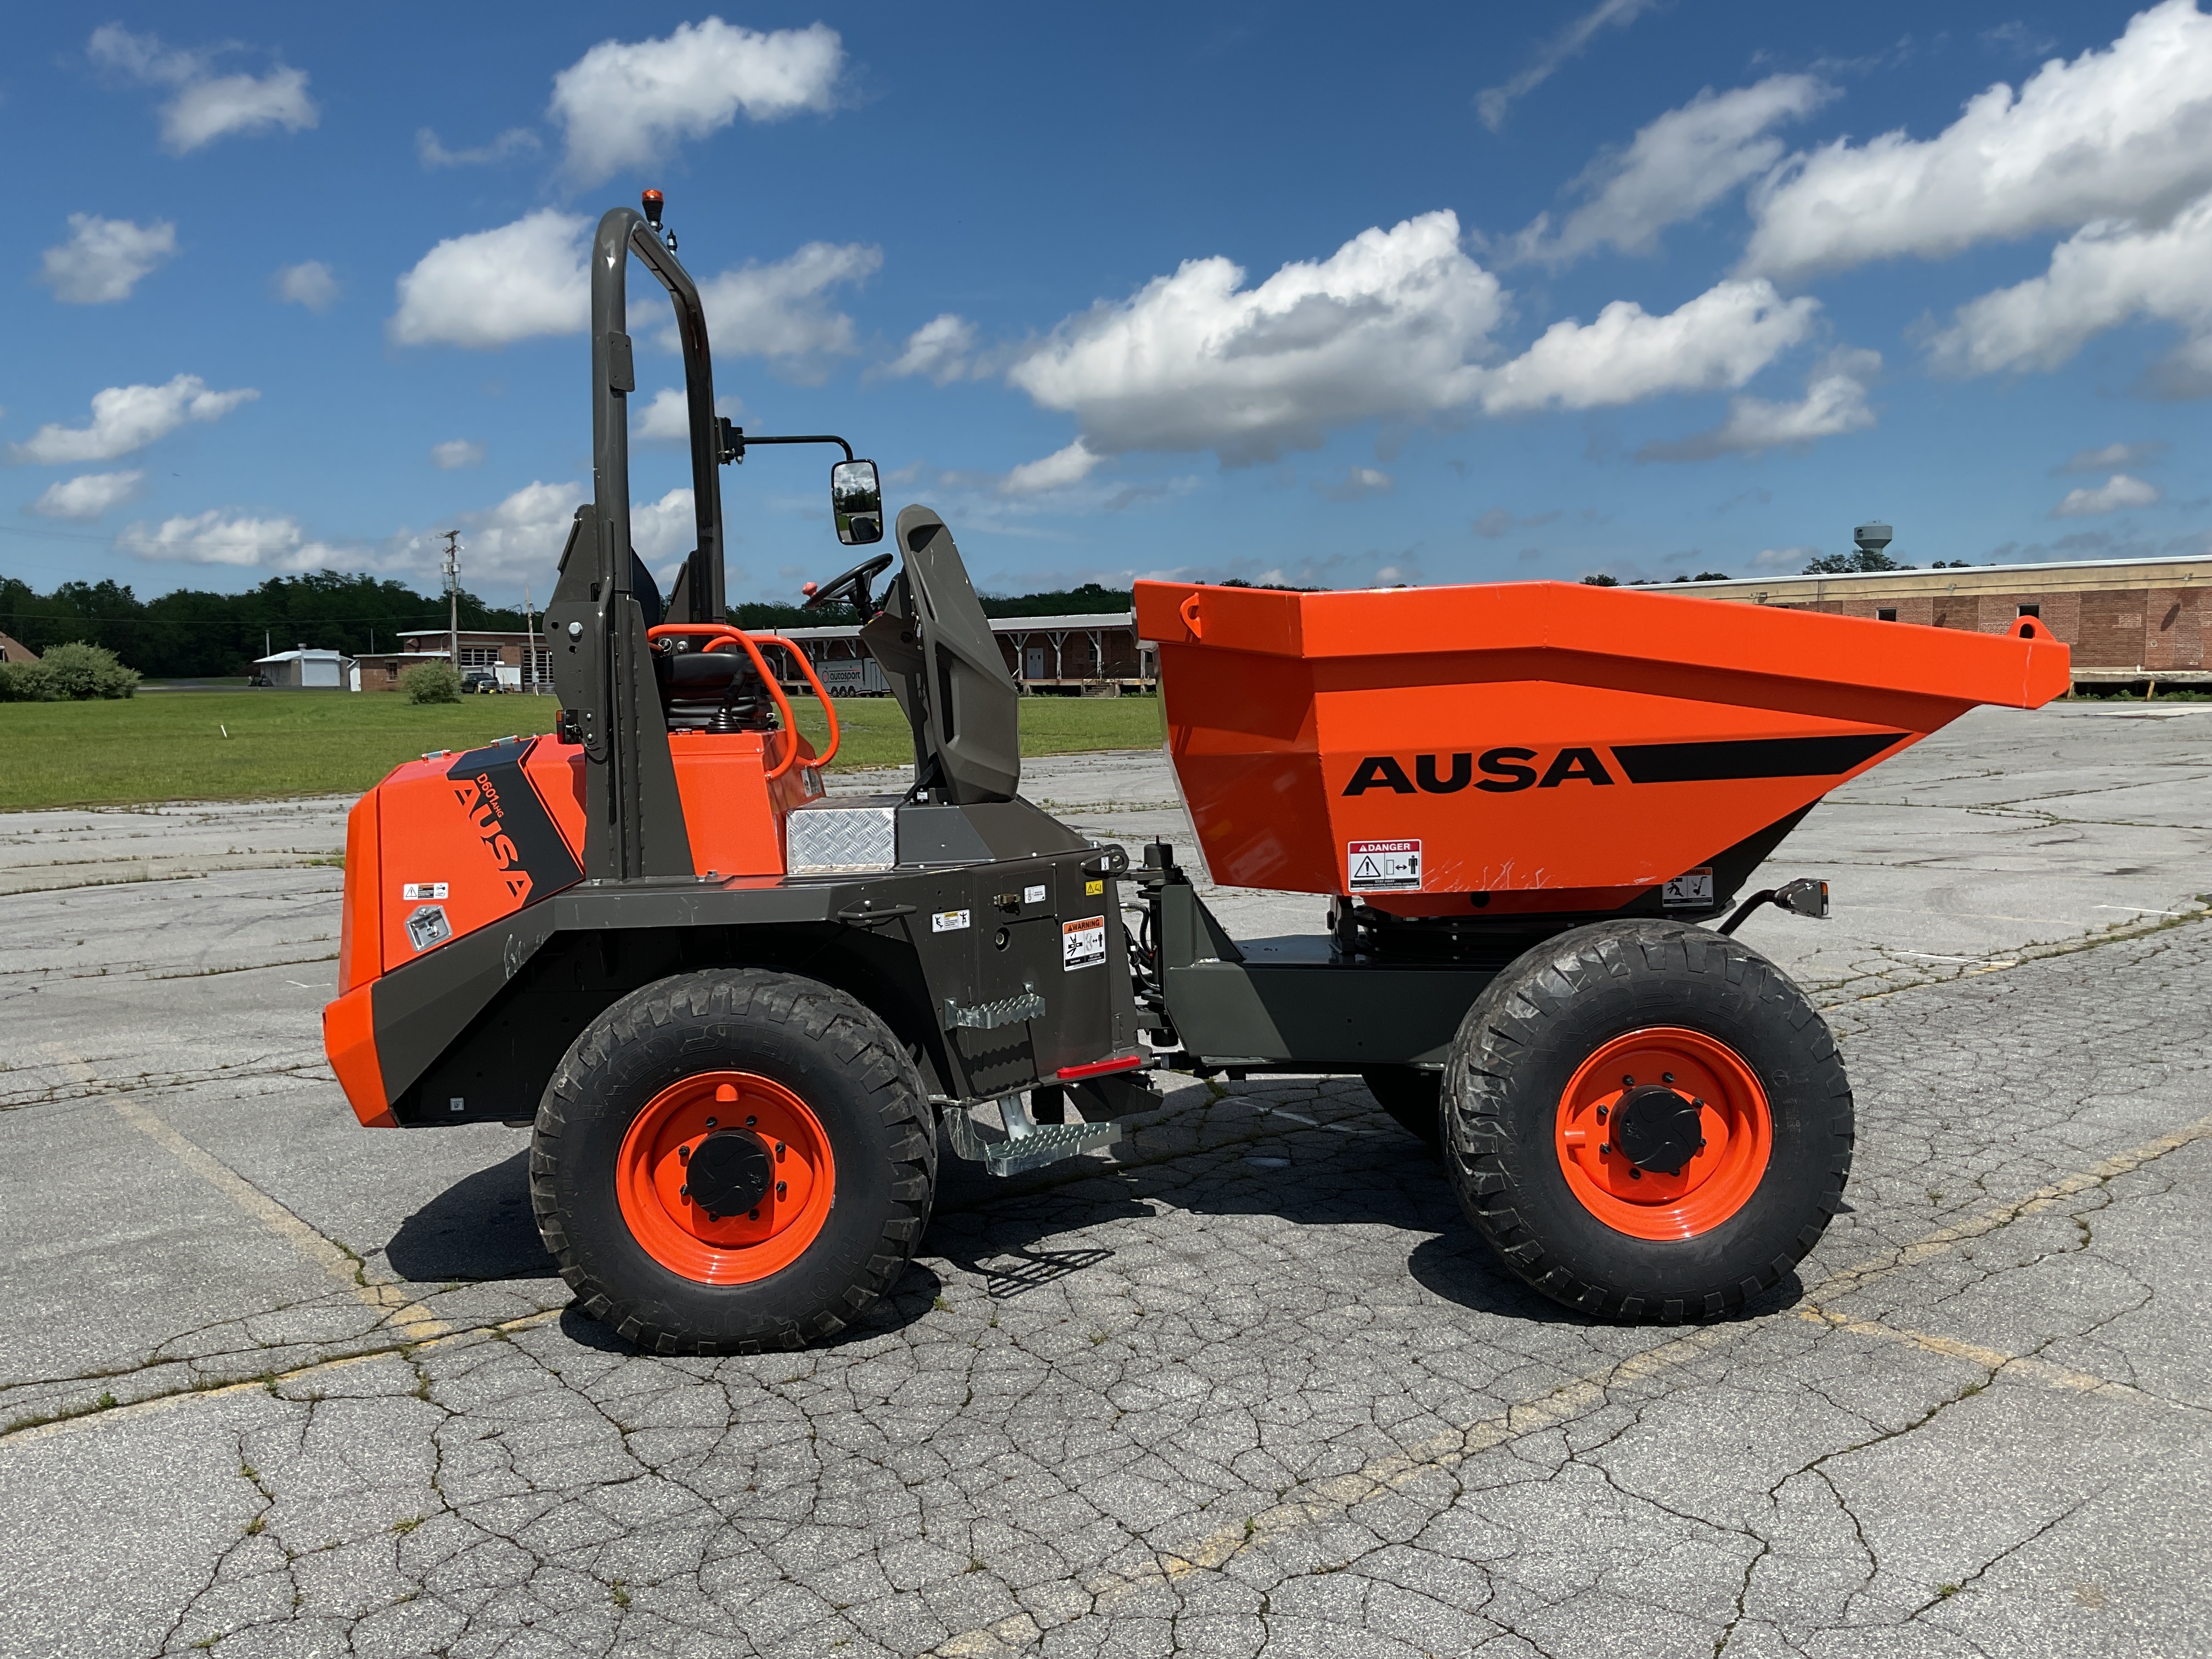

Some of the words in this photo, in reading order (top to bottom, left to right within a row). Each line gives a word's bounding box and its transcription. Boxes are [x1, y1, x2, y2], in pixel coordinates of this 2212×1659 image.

[830, 672, 860, 682] autosport
[1341, 747, 1616, 797] AUSA
[449, 779, 534, 909] AUSA
[1368, 843, 1410, 851] DANGER
[1072, 919, 1100, 930] WARNING
[571, 1023, 821, 1121] VREDESTEIN
